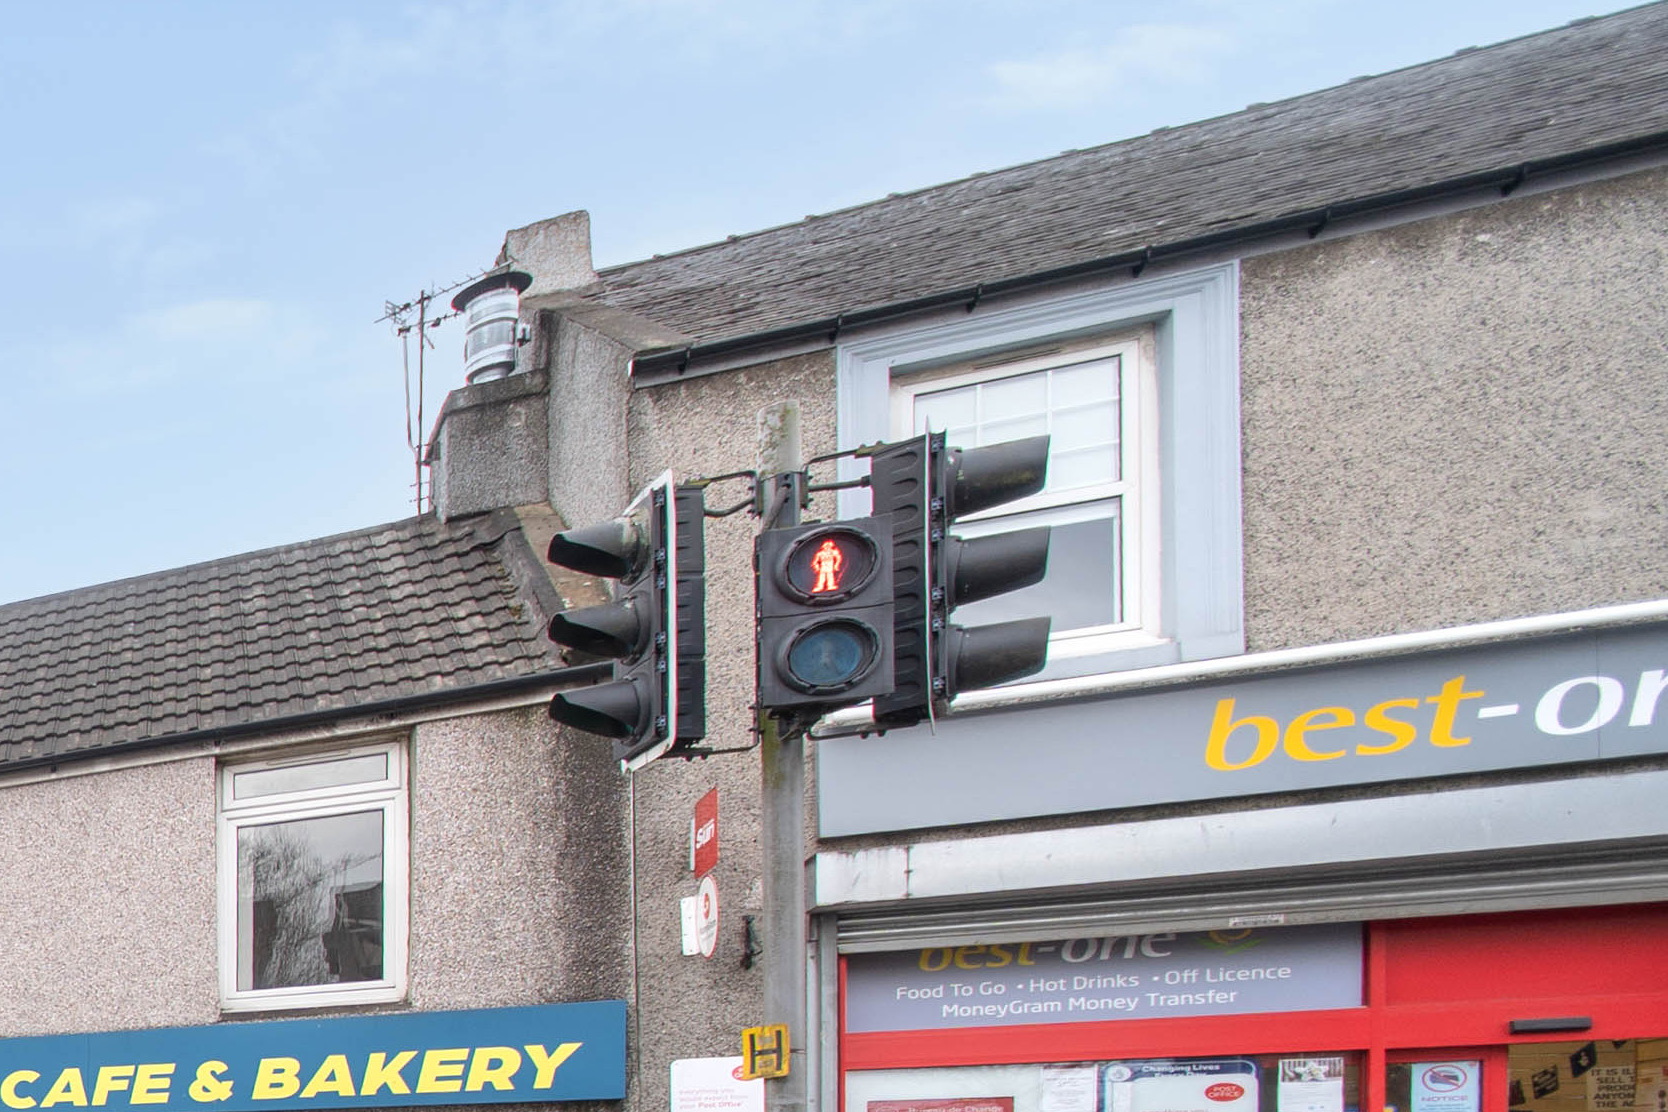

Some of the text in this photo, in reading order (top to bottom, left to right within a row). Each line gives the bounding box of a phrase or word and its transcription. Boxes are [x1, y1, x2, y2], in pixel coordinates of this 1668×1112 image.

[895, 966, 1292, 1000] Food To Go Hot Drinks Off Licence
[942, 989, 1238, 1018] MoneyGram Money Transfer
[749, 1030, 782, 1074] H
[0, 1063, 176, 1110] CAFE
[188, 1060, 234, 1103] &
[251, 1042, 584, 1100] BAKERY
